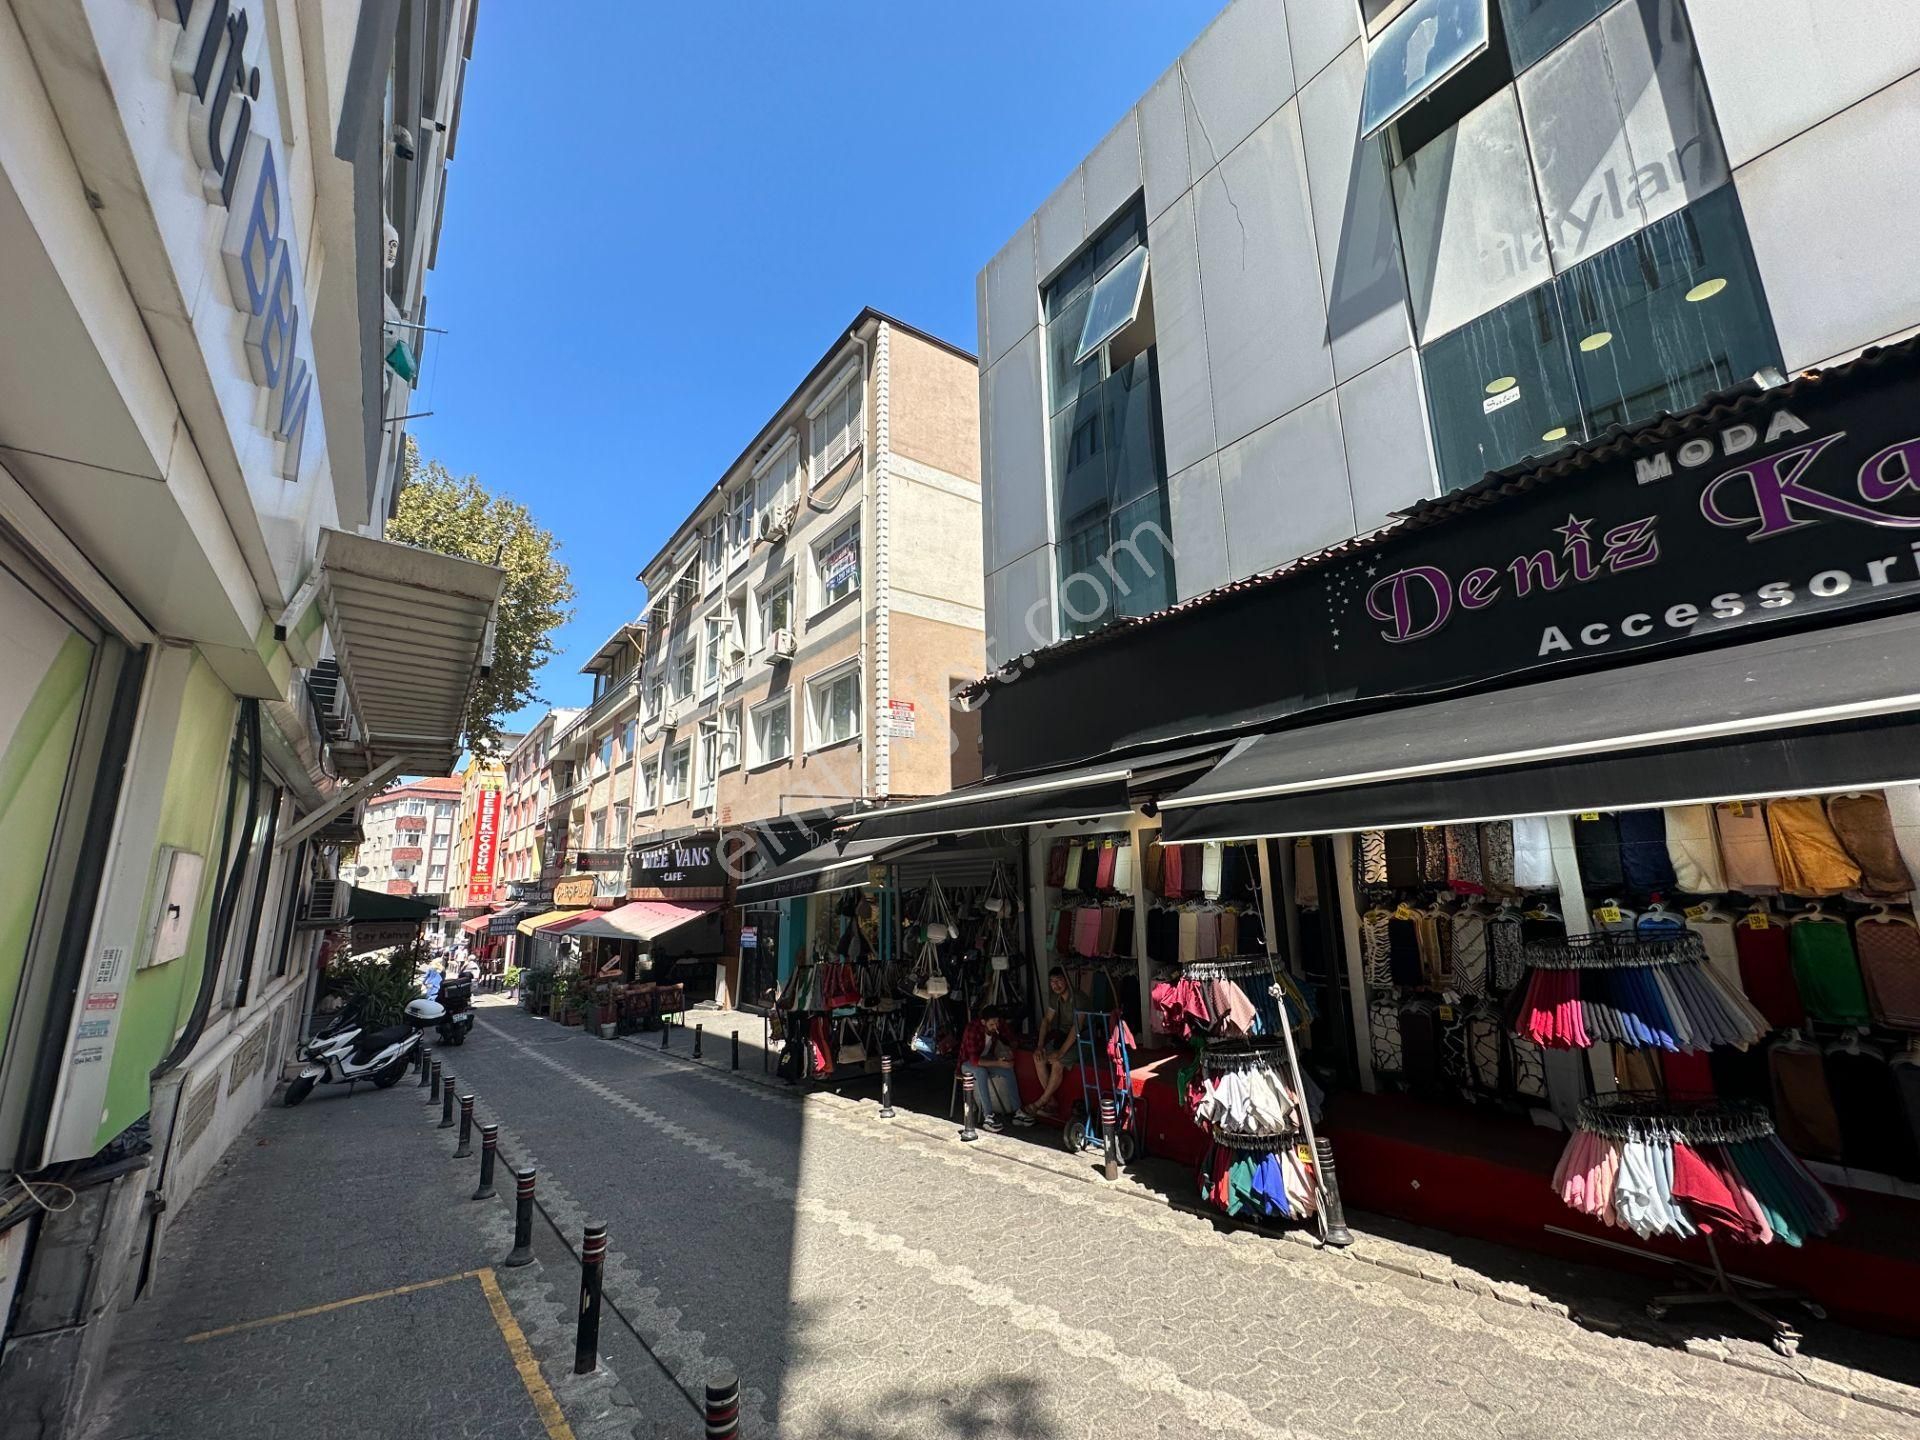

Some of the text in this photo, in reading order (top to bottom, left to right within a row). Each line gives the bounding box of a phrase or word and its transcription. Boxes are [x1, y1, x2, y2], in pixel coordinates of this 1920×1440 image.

[1636, 409, 1811, 485] MODA
[1365, 512, 1662, 644] Deniz
[480, 791, 497, 831] BEBEK
[675, 847, 711, 868] VANS
